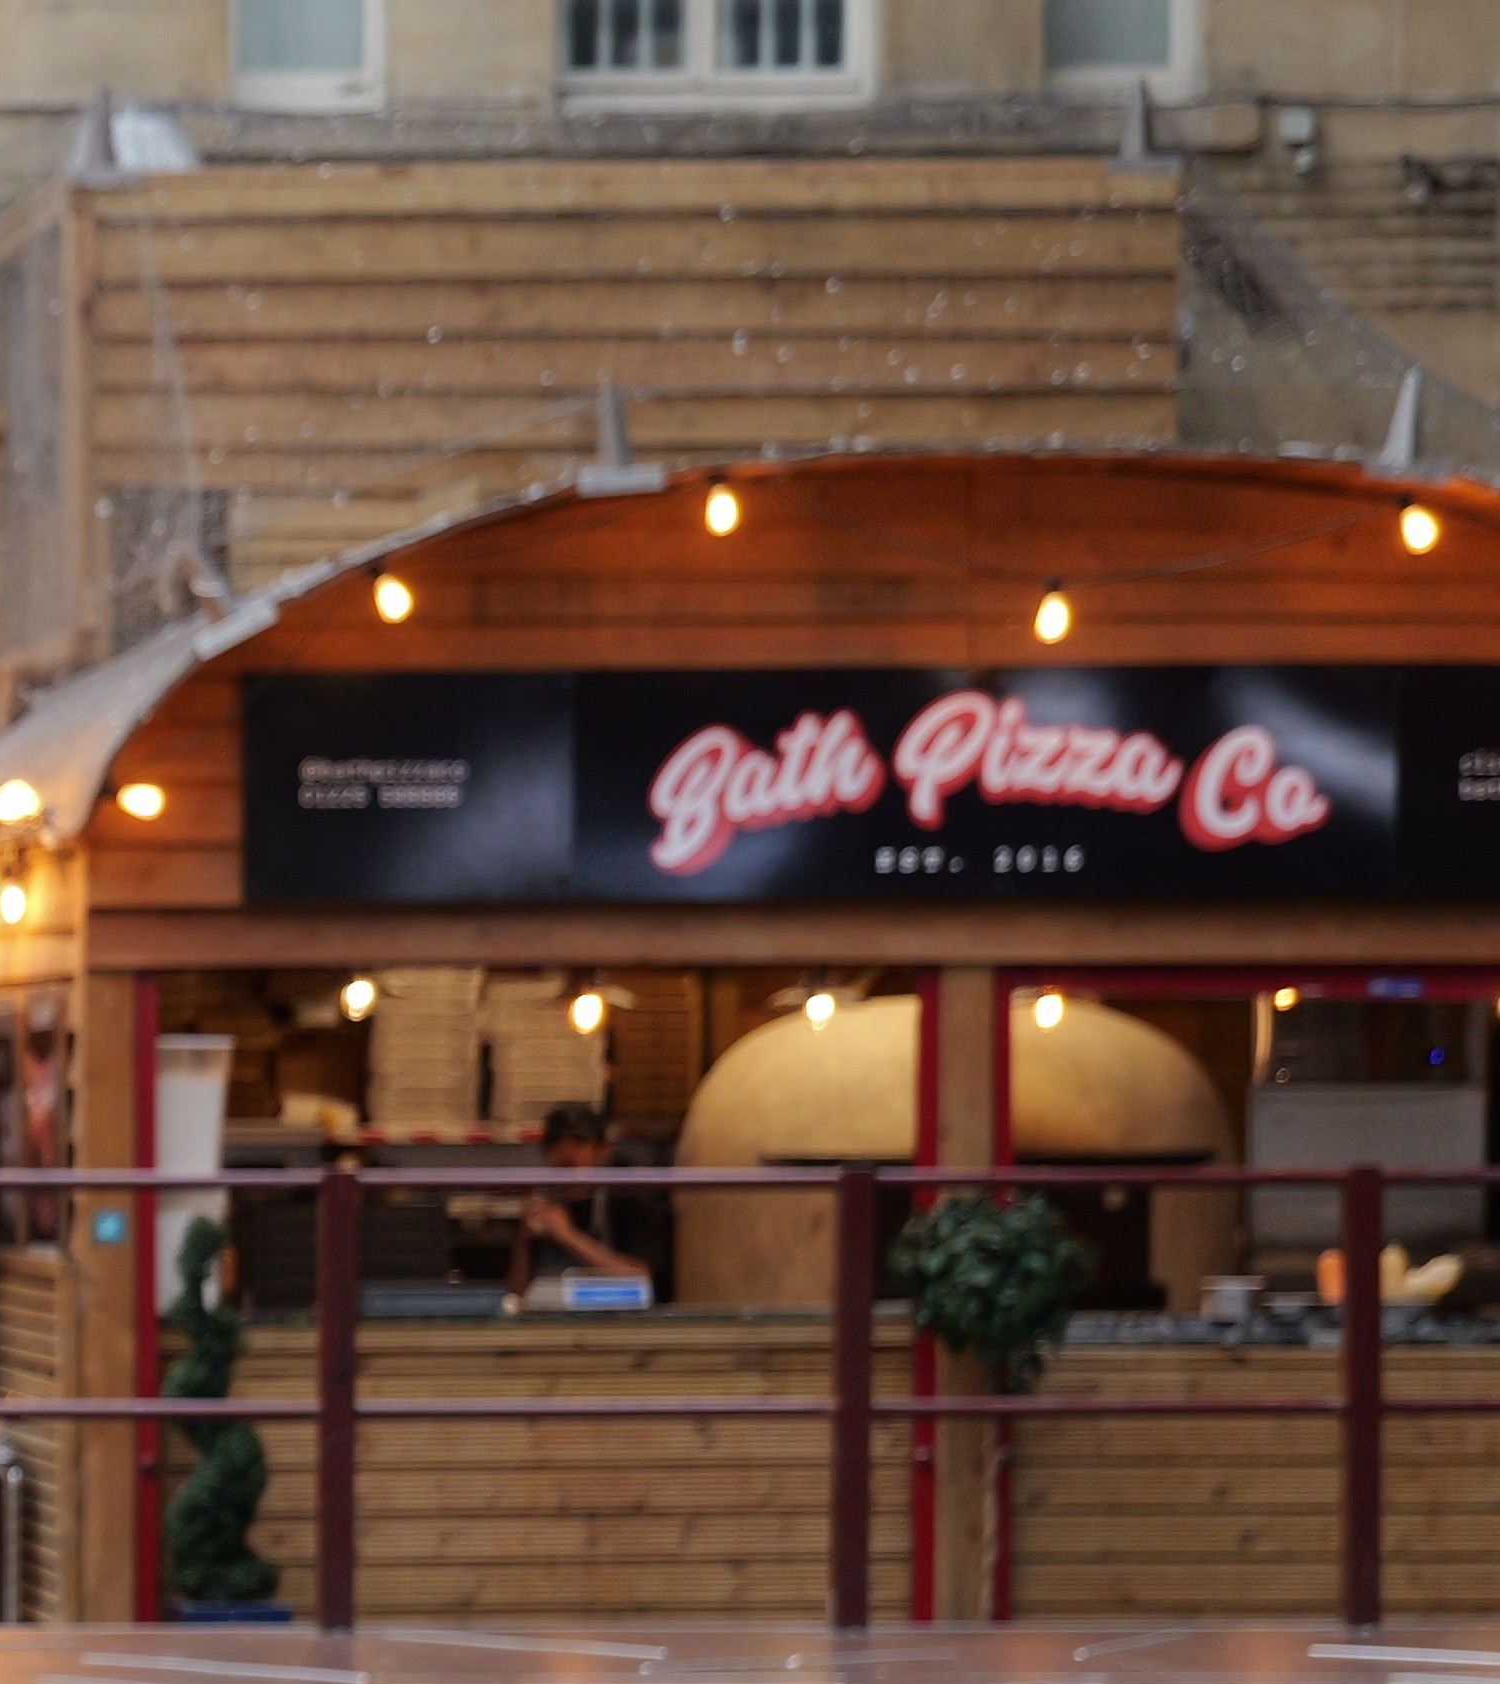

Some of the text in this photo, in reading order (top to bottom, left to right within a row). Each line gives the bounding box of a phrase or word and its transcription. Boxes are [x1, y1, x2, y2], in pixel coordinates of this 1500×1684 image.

[648, 689, 1332, 876] Bath Pizza Co
